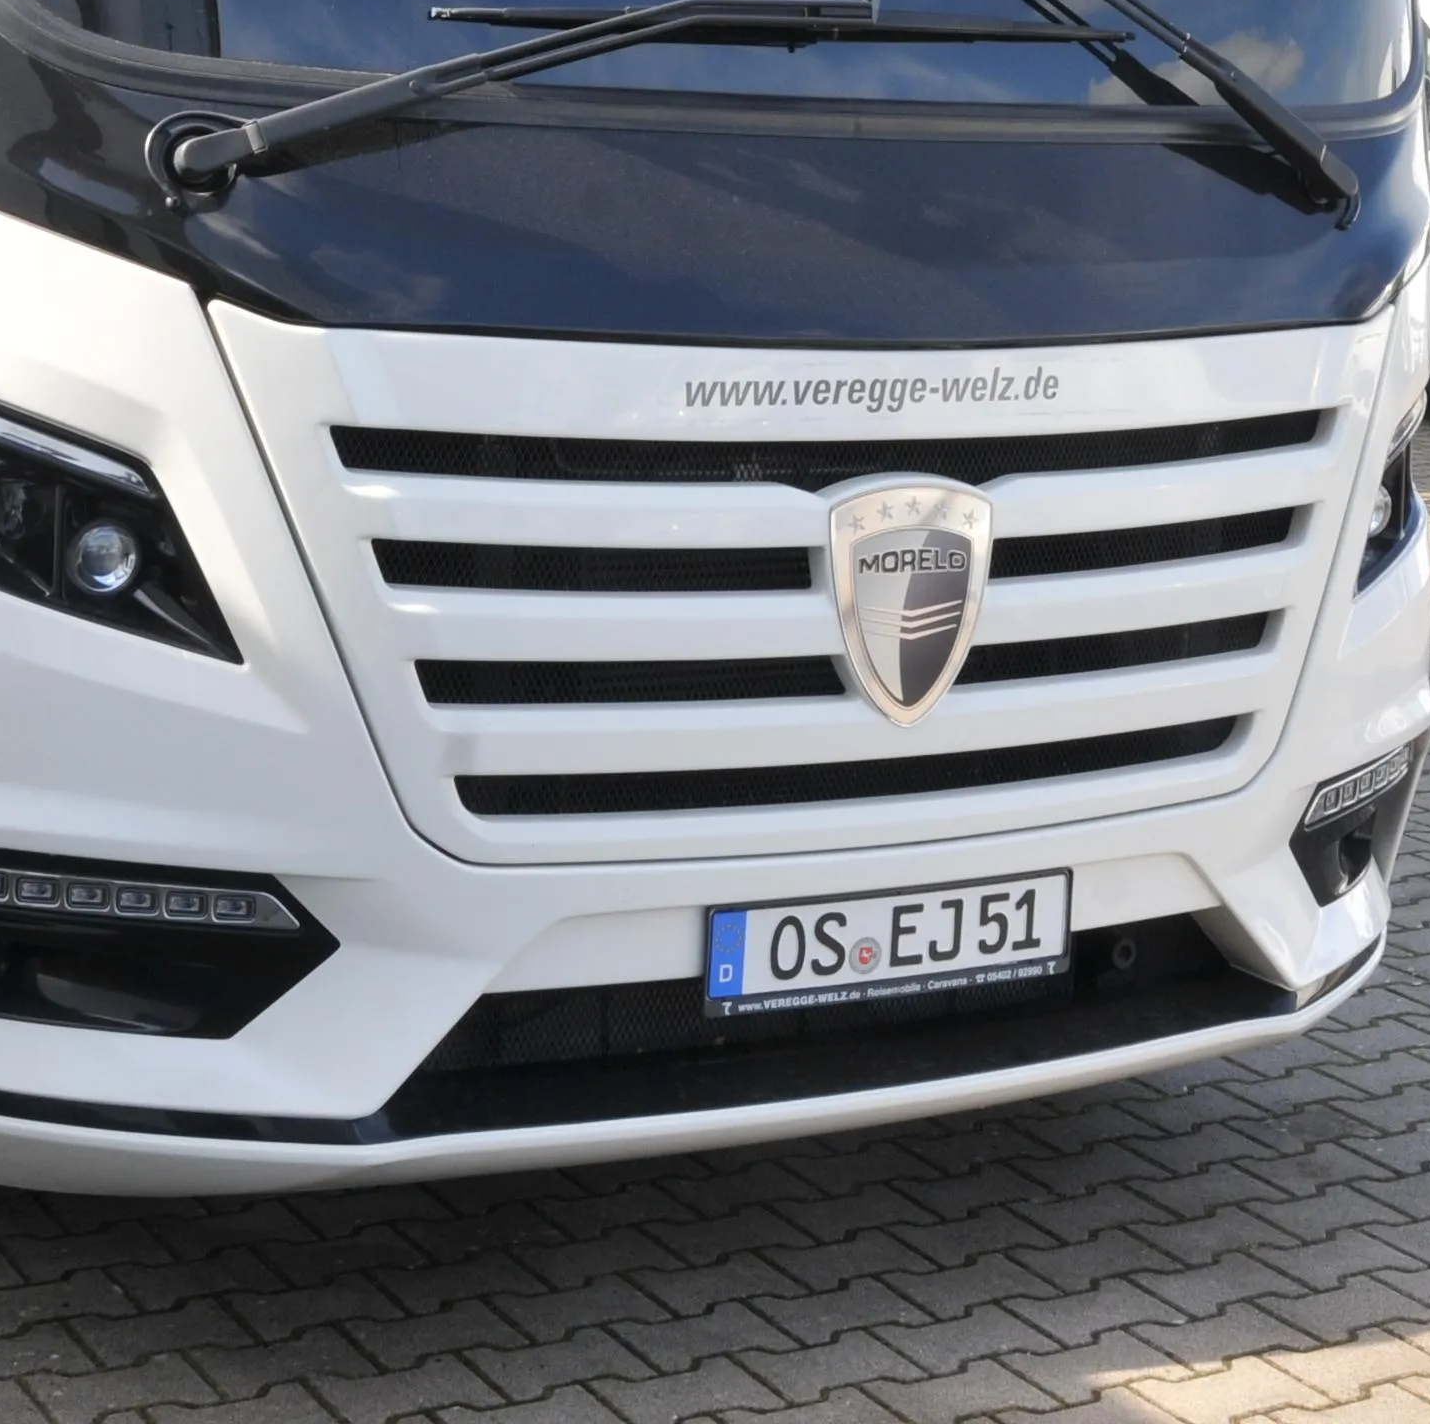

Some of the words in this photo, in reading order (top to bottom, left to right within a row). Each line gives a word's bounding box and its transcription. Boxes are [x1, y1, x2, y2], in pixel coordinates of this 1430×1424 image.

[684, 366, 1060, 413] www.veregge-welz.de
[858, 548, 967, 575] MORELO
[770, 911, 848, 981] OS
[719, 964, 733, 983] D
